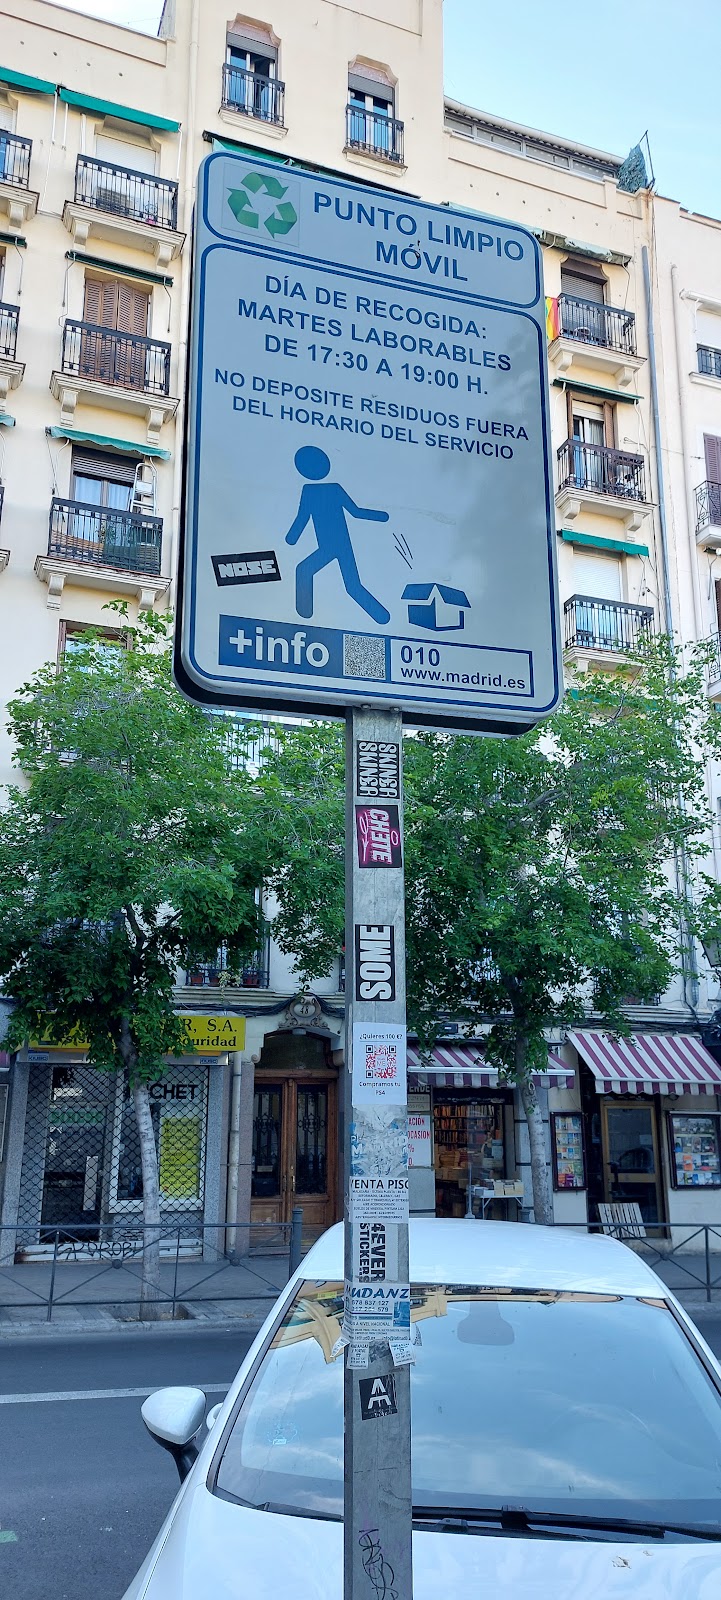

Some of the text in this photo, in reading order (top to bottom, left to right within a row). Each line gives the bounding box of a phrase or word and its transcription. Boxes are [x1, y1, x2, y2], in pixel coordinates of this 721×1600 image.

[313, 191, 524, 261] PUNTO LIMPIO
[375, 240, 468, 282] MÓVIL
[265, 275, 487, 339] DÍA DE RECOGIDA:
[238, 298, 512, 372] MARTES LABORABLES
[264, 334, 488, 395] DE 17:30 A 19:00 H.
[214, 368, 529, 441] NO DEPOSITE RESIDUOS FUERA
[232, 396, 514, 460] DEL HORARIO DEL SERVICIO
[218, 558, 277, 579] NOSE
[229, 627, 330, 668] +info
[400, 645, 440, 667] 010
[400, 667, 525, 689] www.madrid.es
[360, 925, 392, 1000] SOME
[207, 1018, 237, 1032] S.A.
[147, 1082, 199, 1100] CHET
